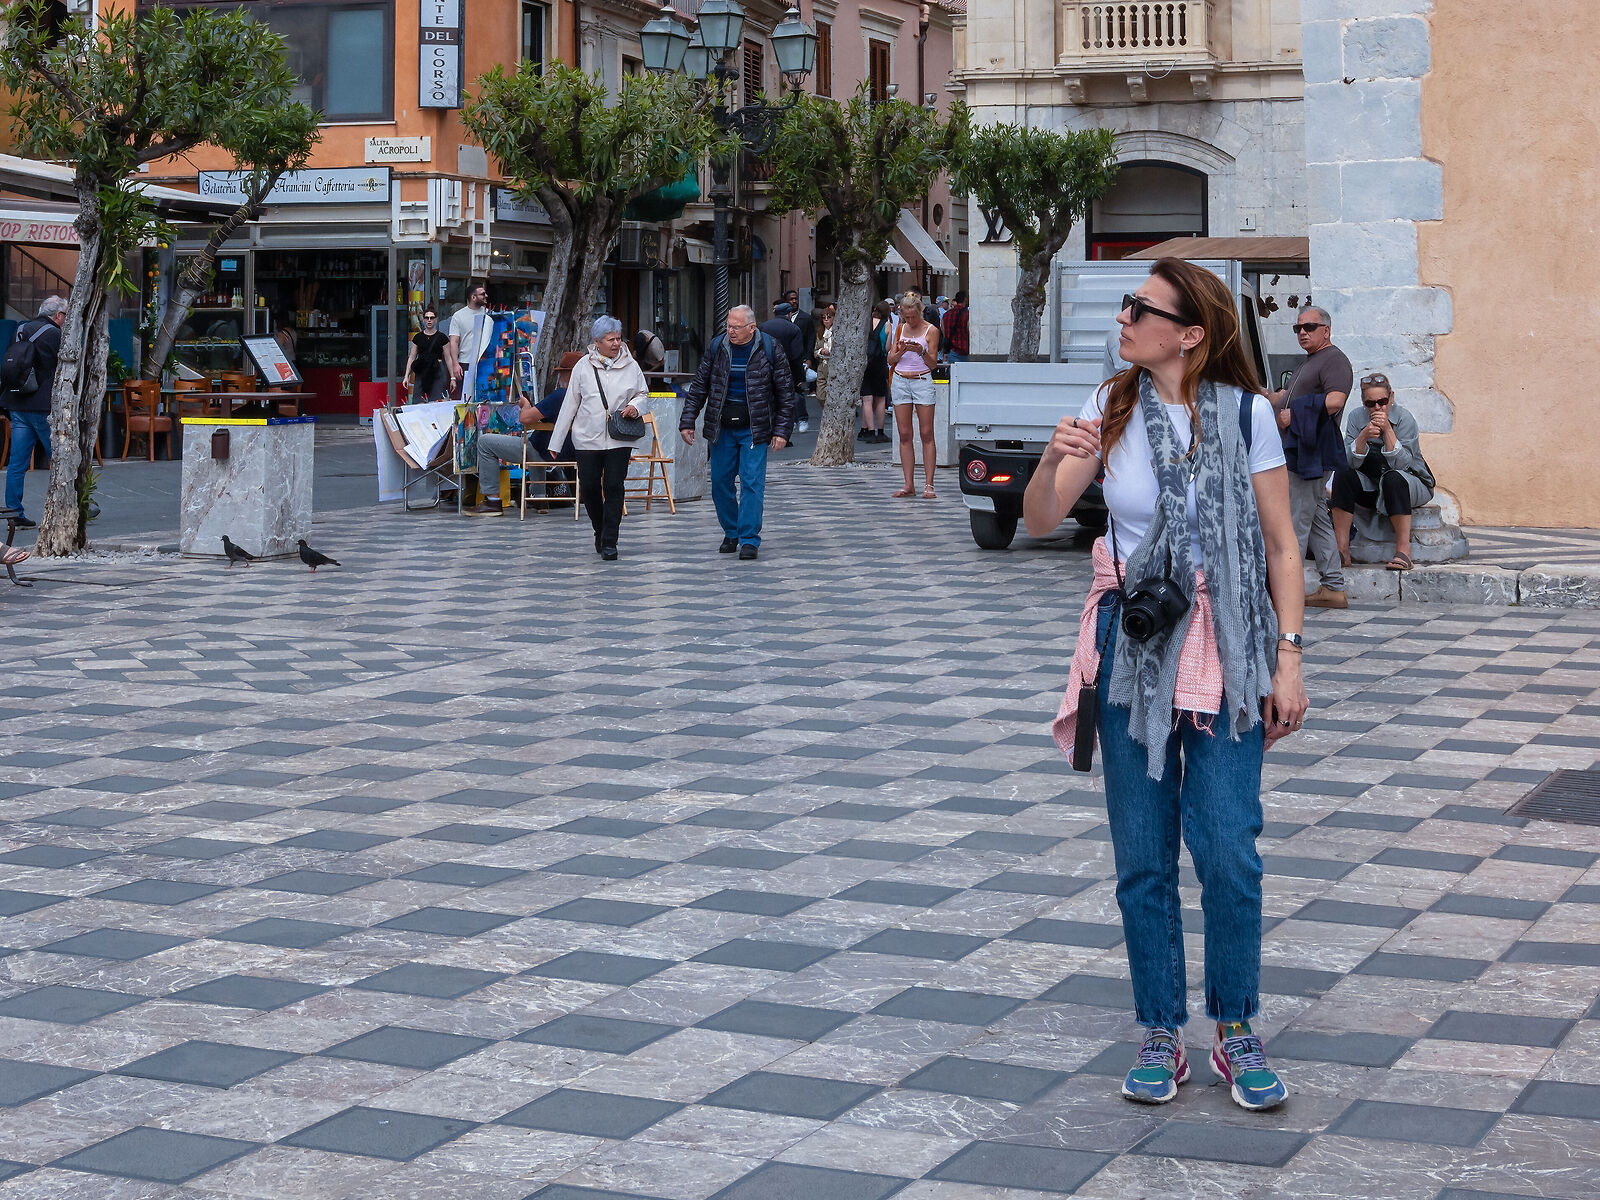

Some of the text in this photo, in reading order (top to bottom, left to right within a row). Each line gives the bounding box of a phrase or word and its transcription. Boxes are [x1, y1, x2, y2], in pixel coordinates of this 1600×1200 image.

[425, 31, 454, 41] DEL
[432, 47, 446, 101] CORSO
[378, 145, 418, 155] ACROPOLI
[201, 179, 237, 195] Gelateria
[274, 177, 312, 193] Arancini
[314, 176, 355, 196] Caffetteria
